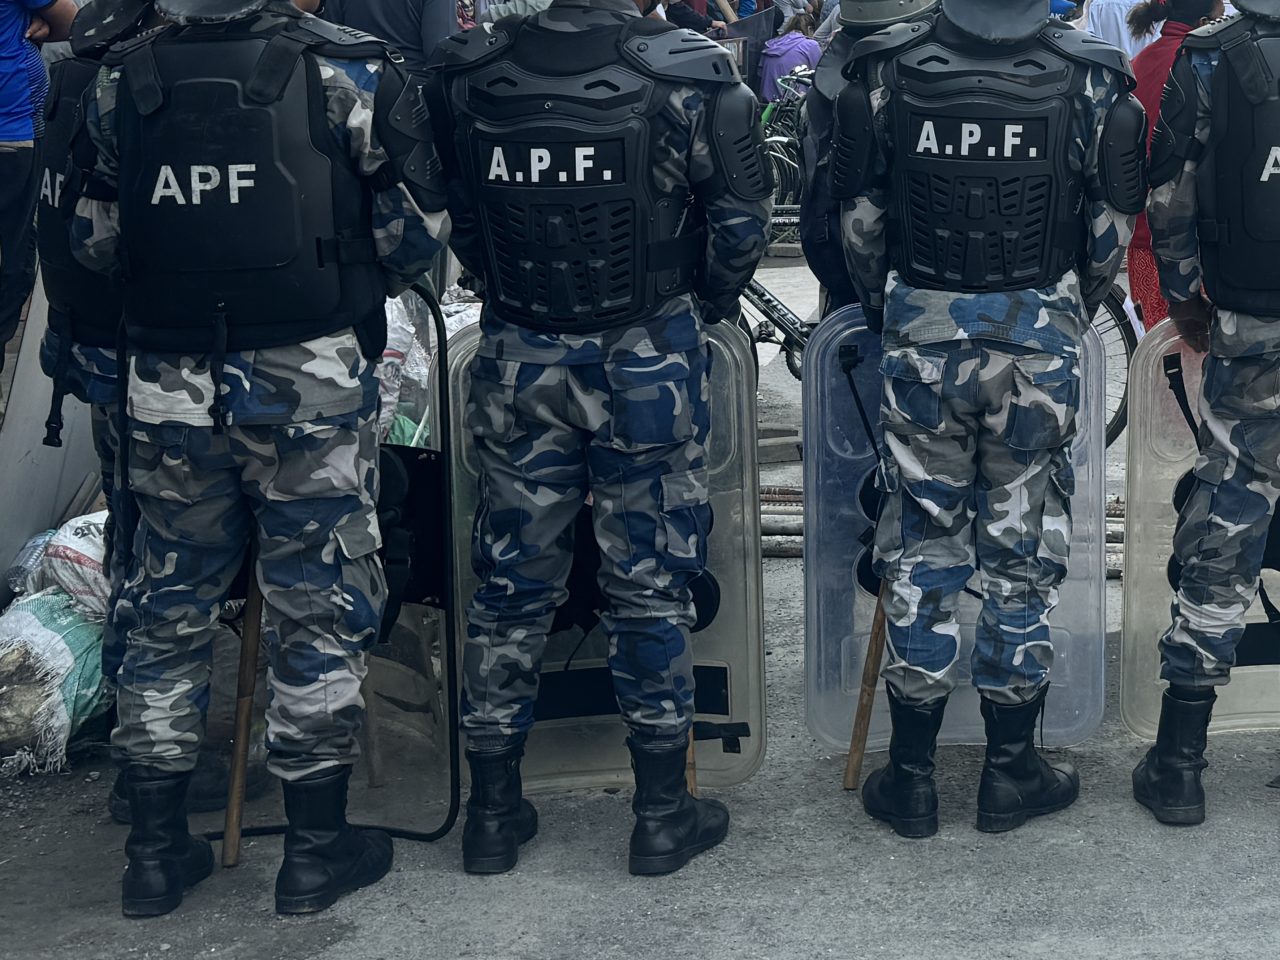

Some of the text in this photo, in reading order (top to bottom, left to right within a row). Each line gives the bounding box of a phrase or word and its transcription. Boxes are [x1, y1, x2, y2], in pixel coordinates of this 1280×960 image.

[916, 120, 1038, 158] A.P.F.
[488, 145, 613, 182] A.P.F.
[150, 163, 257, 205] APF
